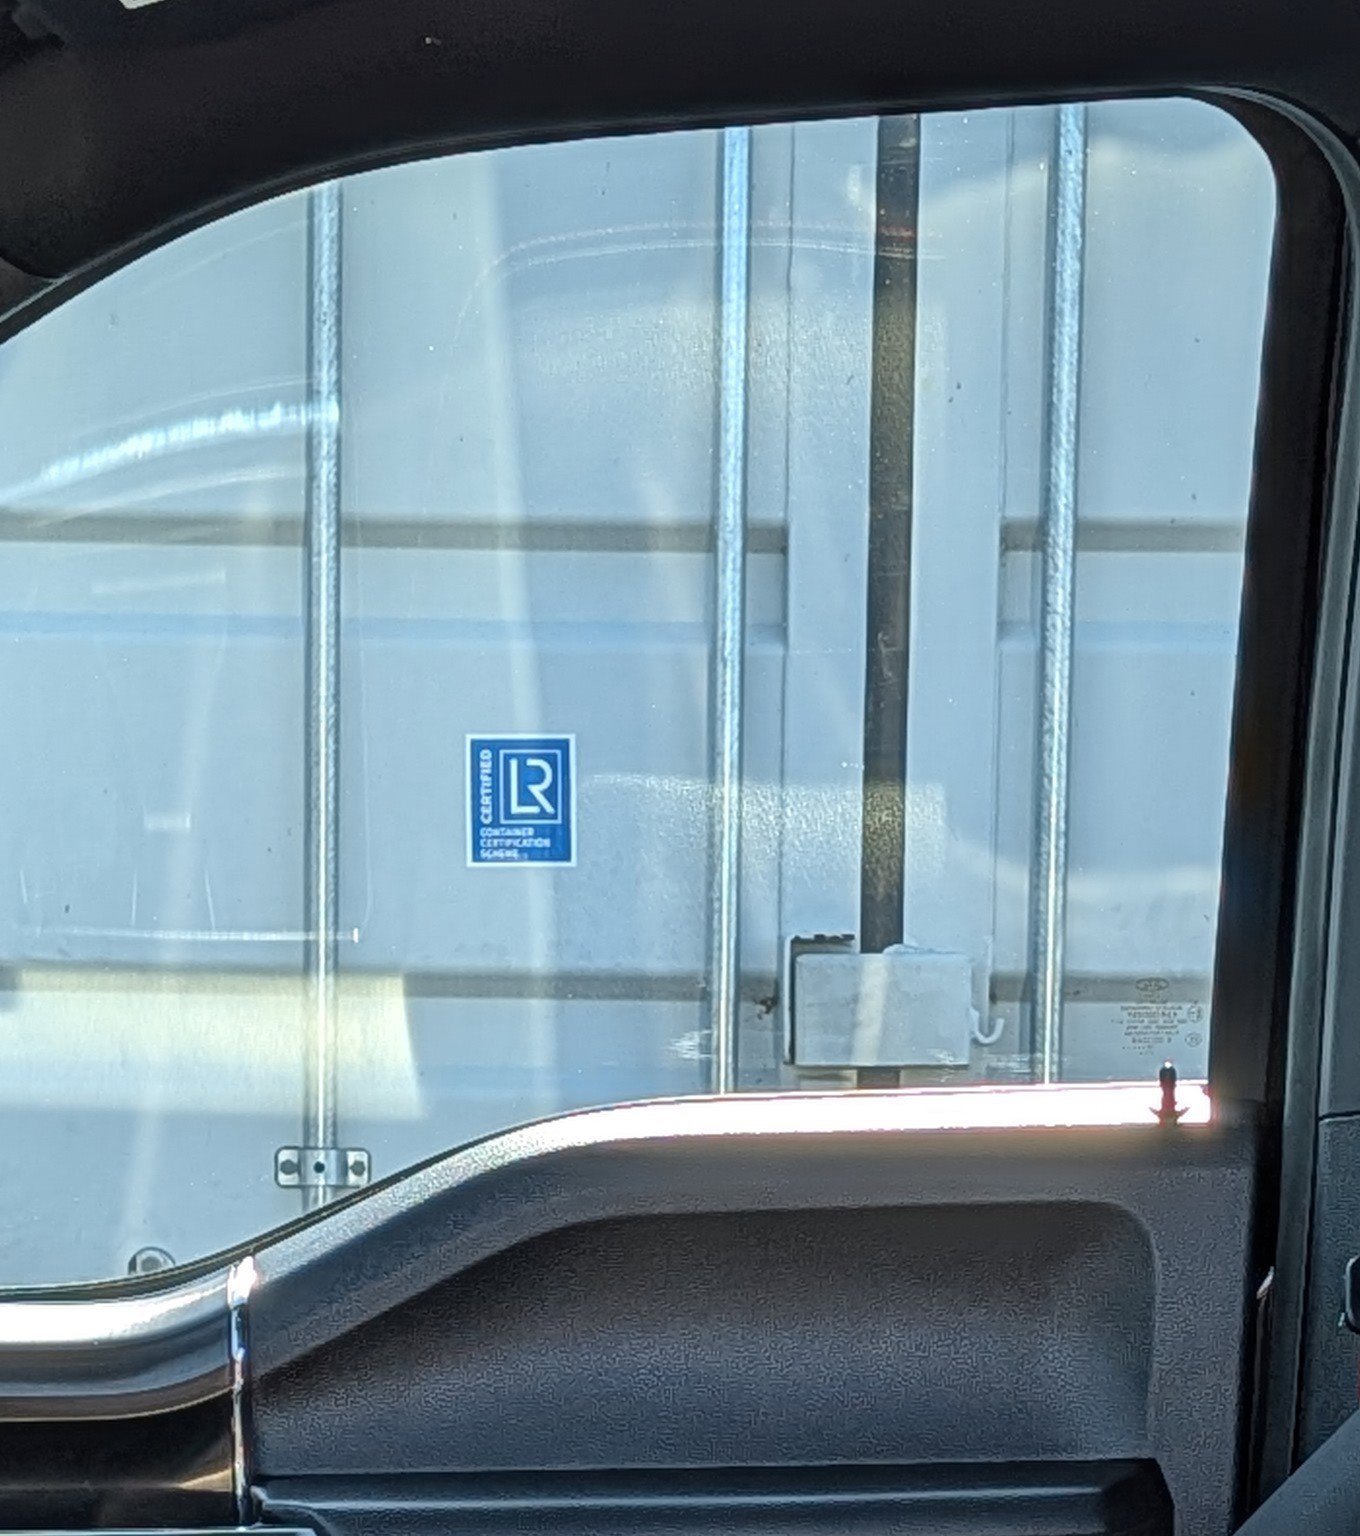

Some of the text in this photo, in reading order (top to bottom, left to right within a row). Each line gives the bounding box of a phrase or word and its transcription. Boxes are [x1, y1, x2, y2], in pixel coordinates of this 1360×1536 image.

[479, 749, 493, 824] CERTIFIED
[509, 757, 556, 815] LR
[479, 827, 535, 838] CONTAINER
[479, 837, 551, 848] CERTIFICATION
